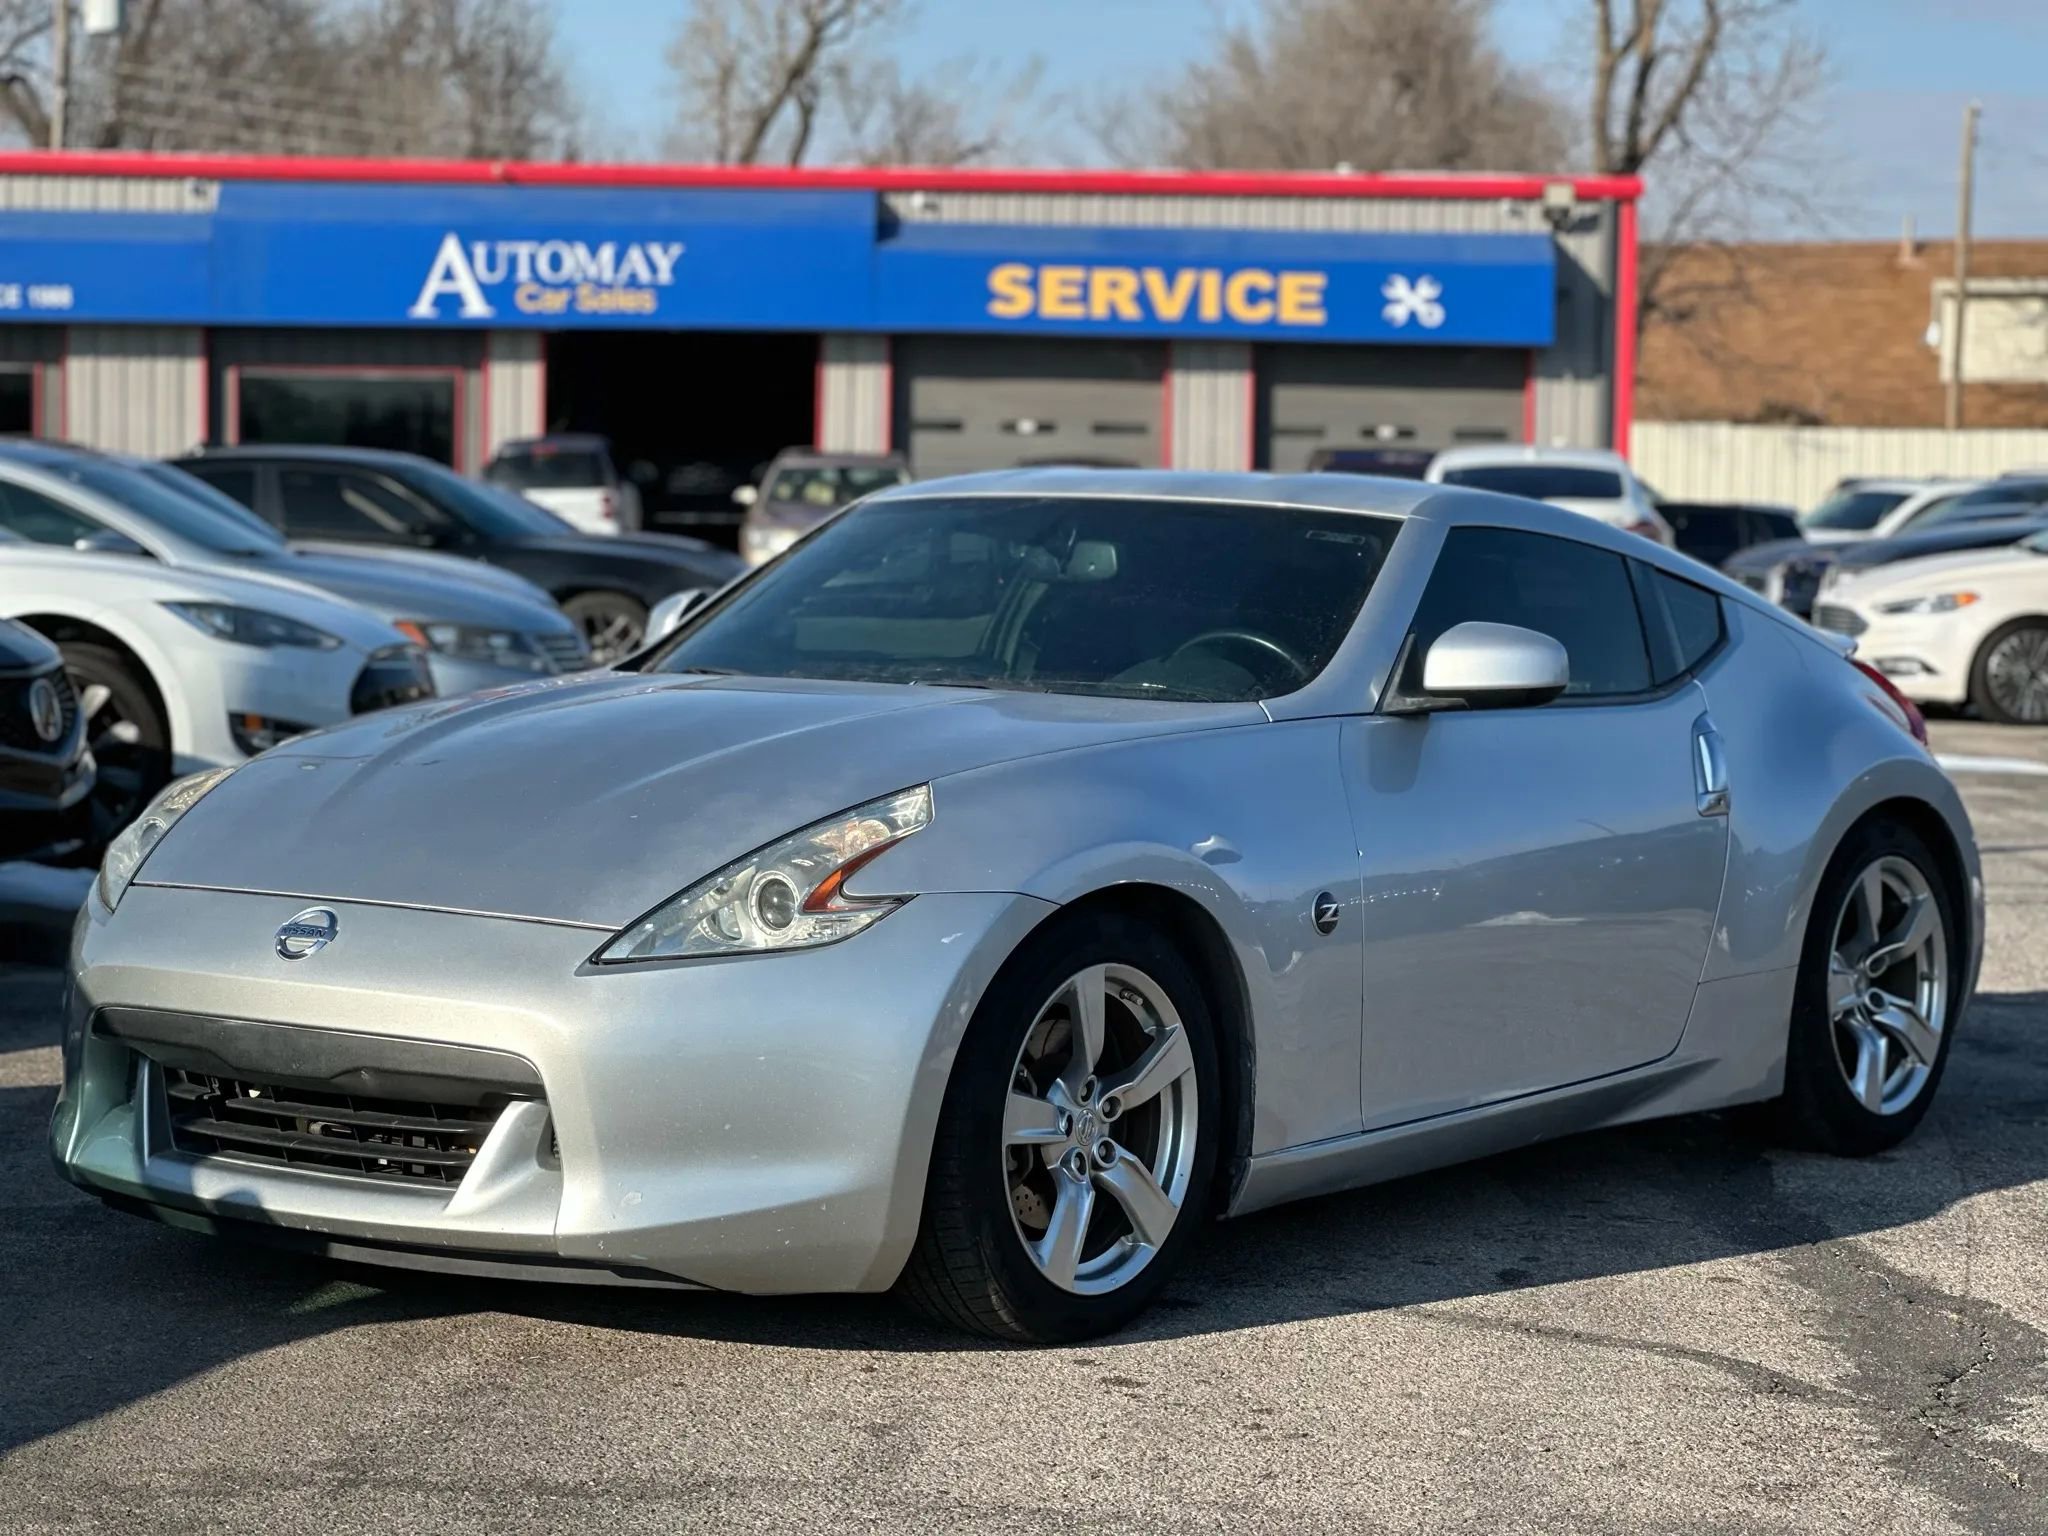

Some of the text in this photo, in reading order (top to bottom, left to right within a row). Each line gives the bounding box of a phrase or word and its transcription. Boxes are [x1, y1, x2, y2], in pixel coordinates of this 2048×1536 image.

[408, 231, 686, 318] AUTOMAY
[514, 281, 658, 315] Car Sales
[986, 262, 1327, 326] SERVICE
[1318, 903, 1339, 923] Z
[280, 925, 328, 938] NISSAN
